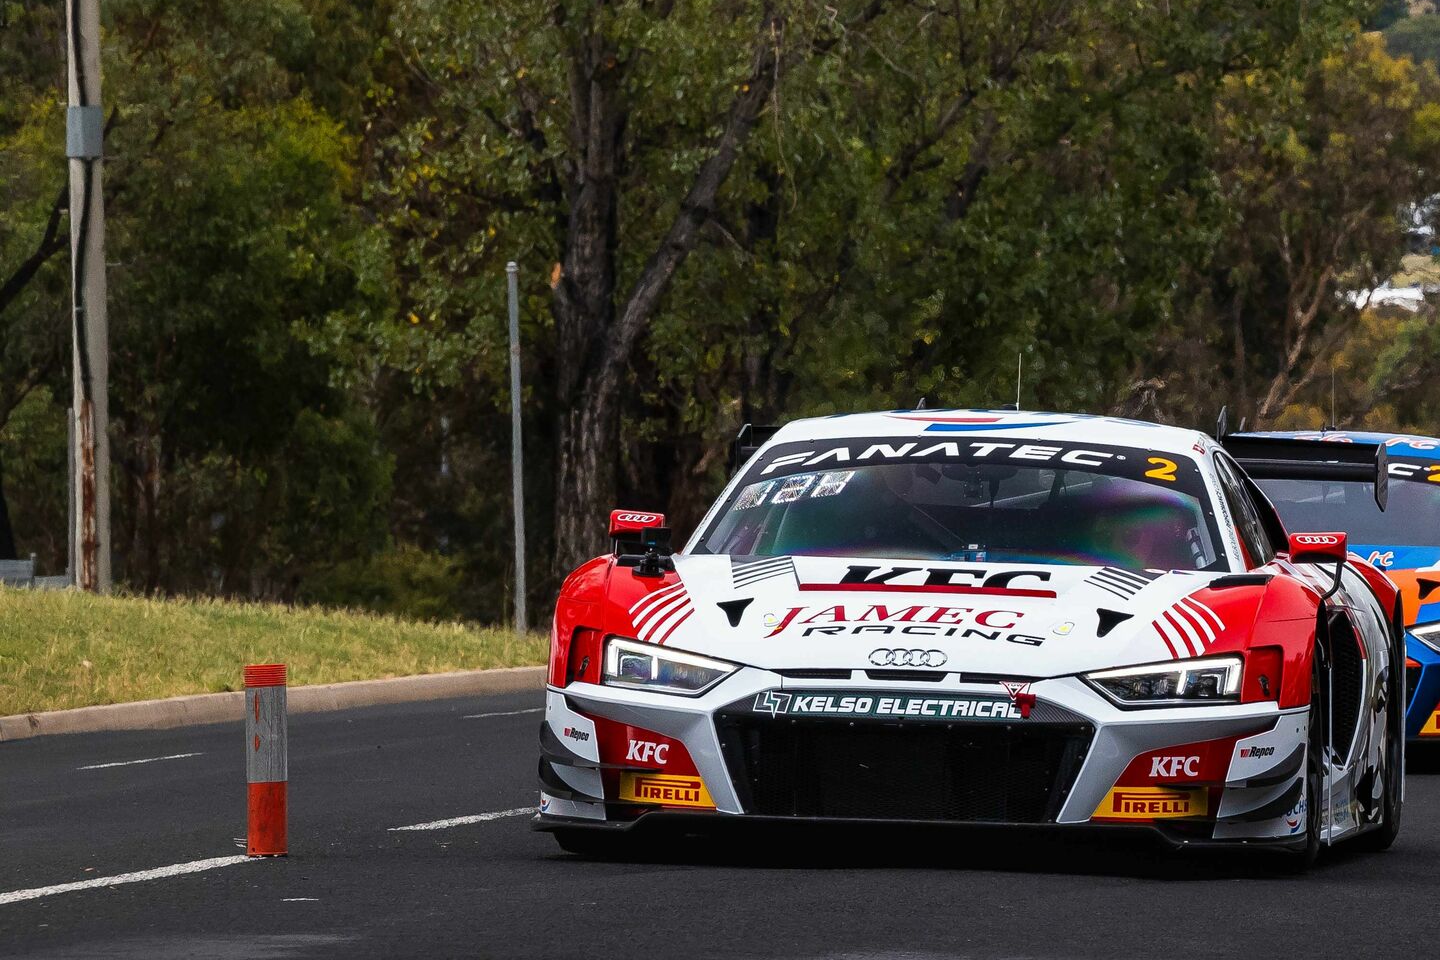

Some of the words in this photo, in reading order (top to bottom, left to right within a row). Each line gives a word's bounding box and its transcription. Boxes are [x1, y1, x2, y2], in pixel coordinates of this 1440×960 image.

[760, 442, 1113, 475] FANATEC
[1144, 457, 1178, 482] 2
[763, 605, 1025, 639] JAMEC
[801, 625, 1046, 647] RACING
[792, 696, 871, 714] KELSO
[875, 698, 1022, 719] ELECTRICAL
[570, 727, 590, 741] Repco
[626, 740, 669, 765] KFC
[1249, 745, 1275, 759] Repco
[1148, 756, 1200, 778] KFC
[634, 776, 701, 802] PIRELLI
[1113, 791, 1191, 814] PIRELLI
